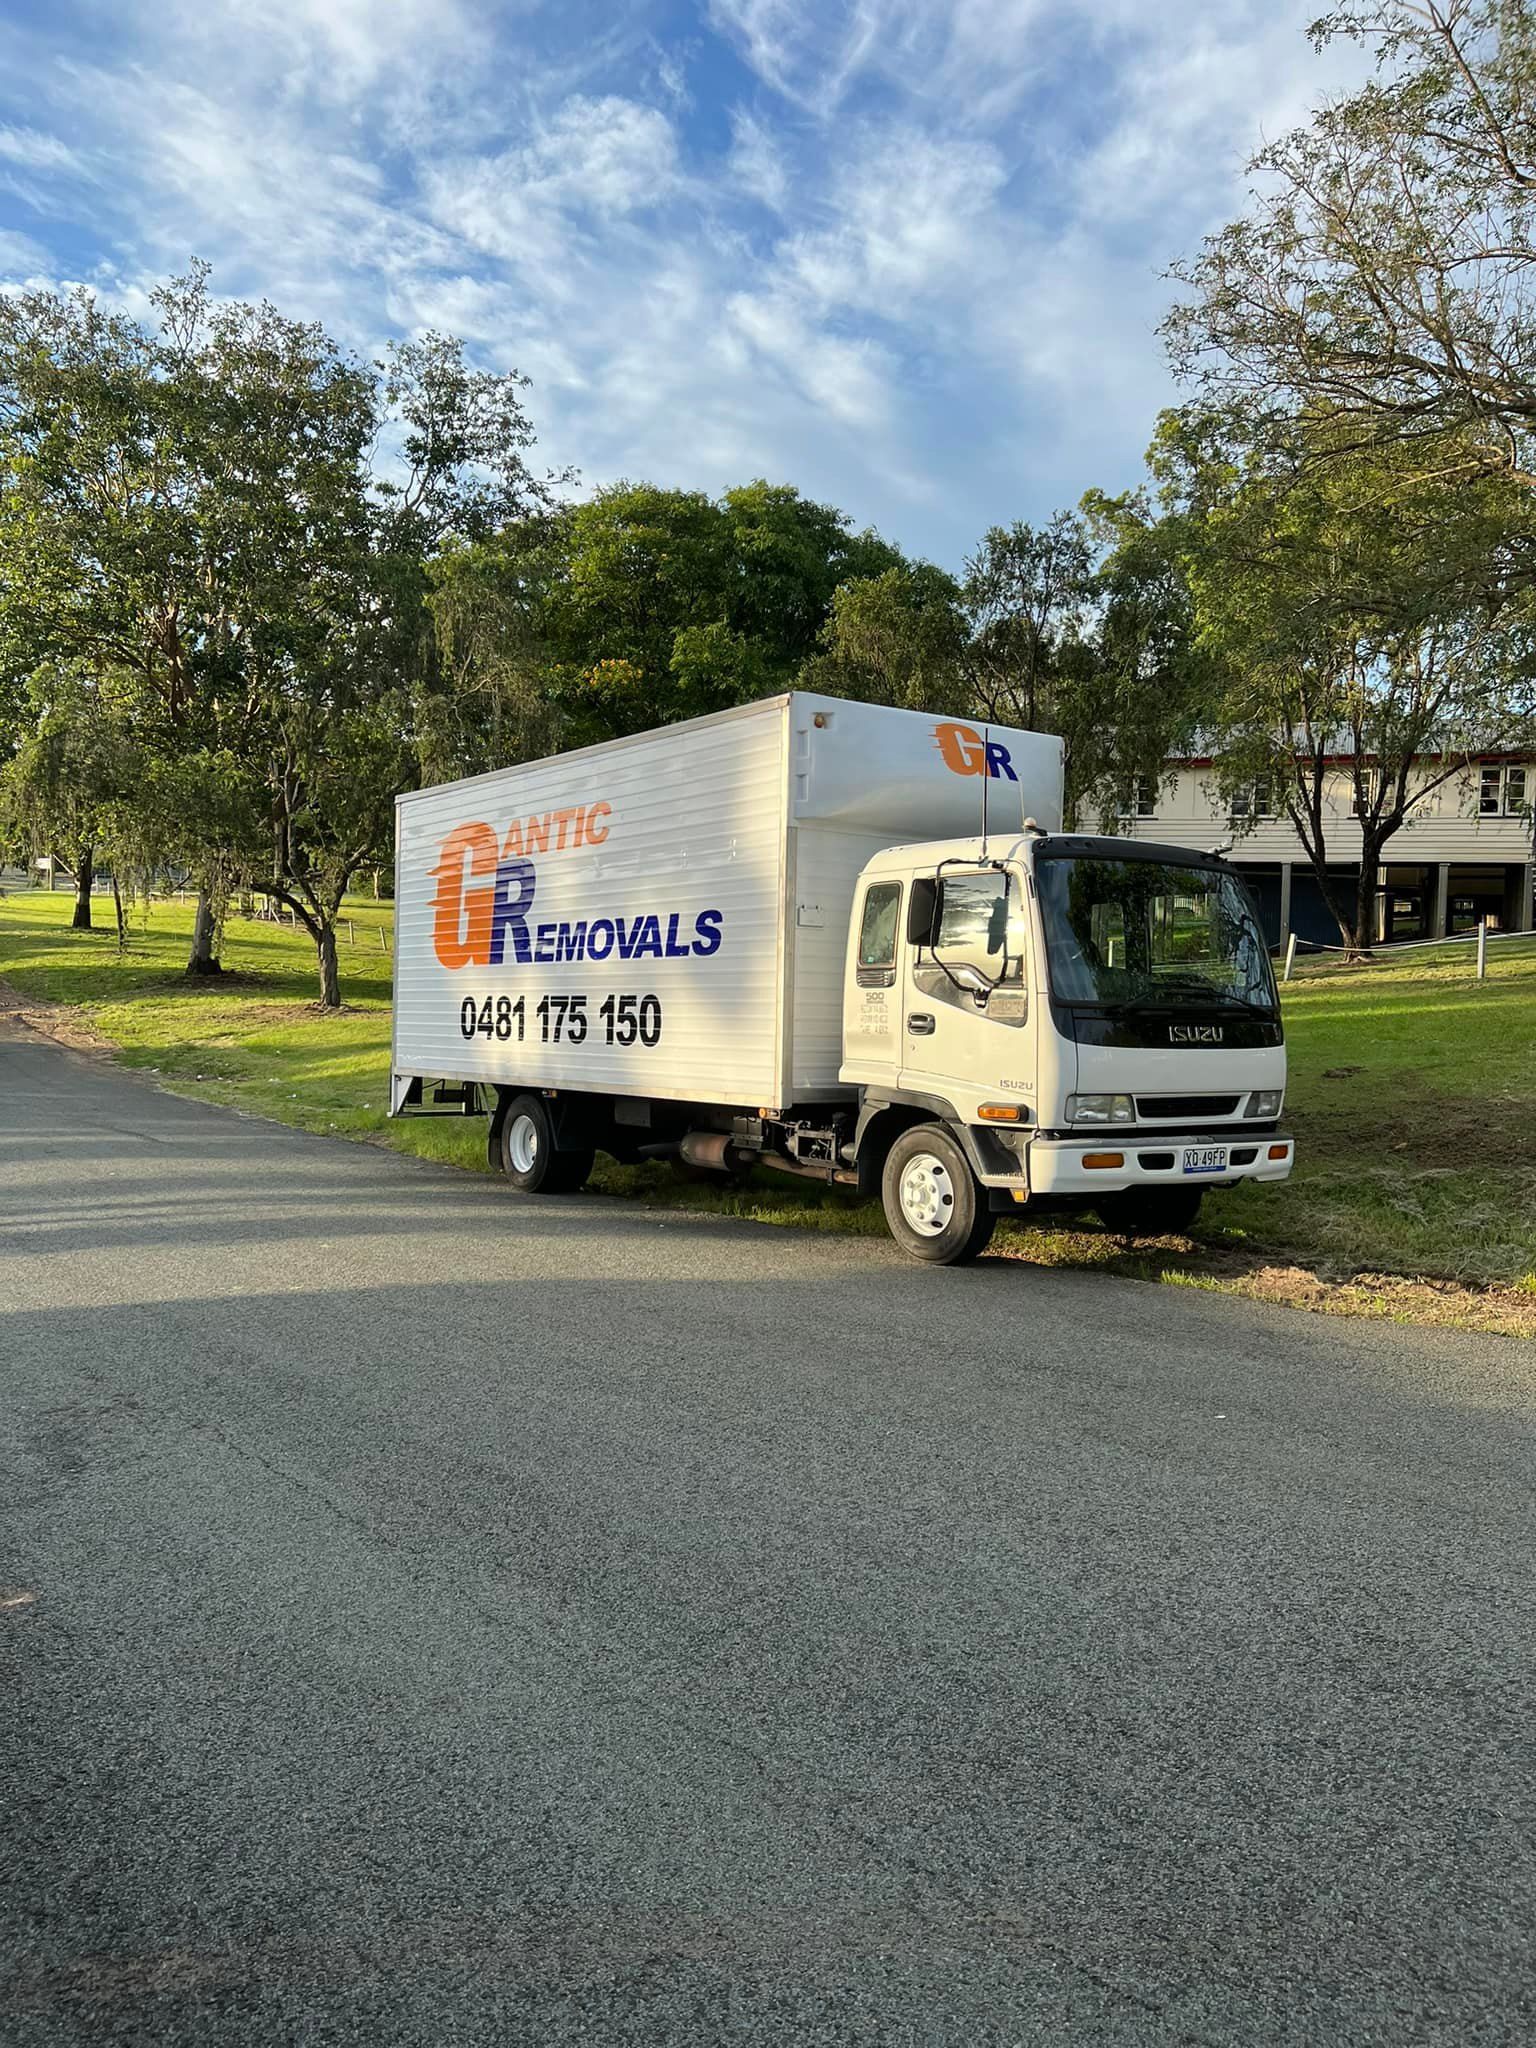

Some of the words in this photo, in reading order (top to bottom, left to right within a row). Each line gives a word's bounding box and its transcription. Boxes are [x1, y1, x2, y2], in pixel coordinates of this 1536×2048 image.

[928, 723, 1018, 782] GR
[489, 858, 723, 964] REMOVALS
[865, 992, 885, 1000] 500
[461, 996, 525, 1042] 0481
[536, 995, 587, 1044] 175
[600, 994, 661, 1047] 150
[1169, 1026, 1223, 1042] ISUZU
[1000, 1080, 1033, 1090] ISUZU
